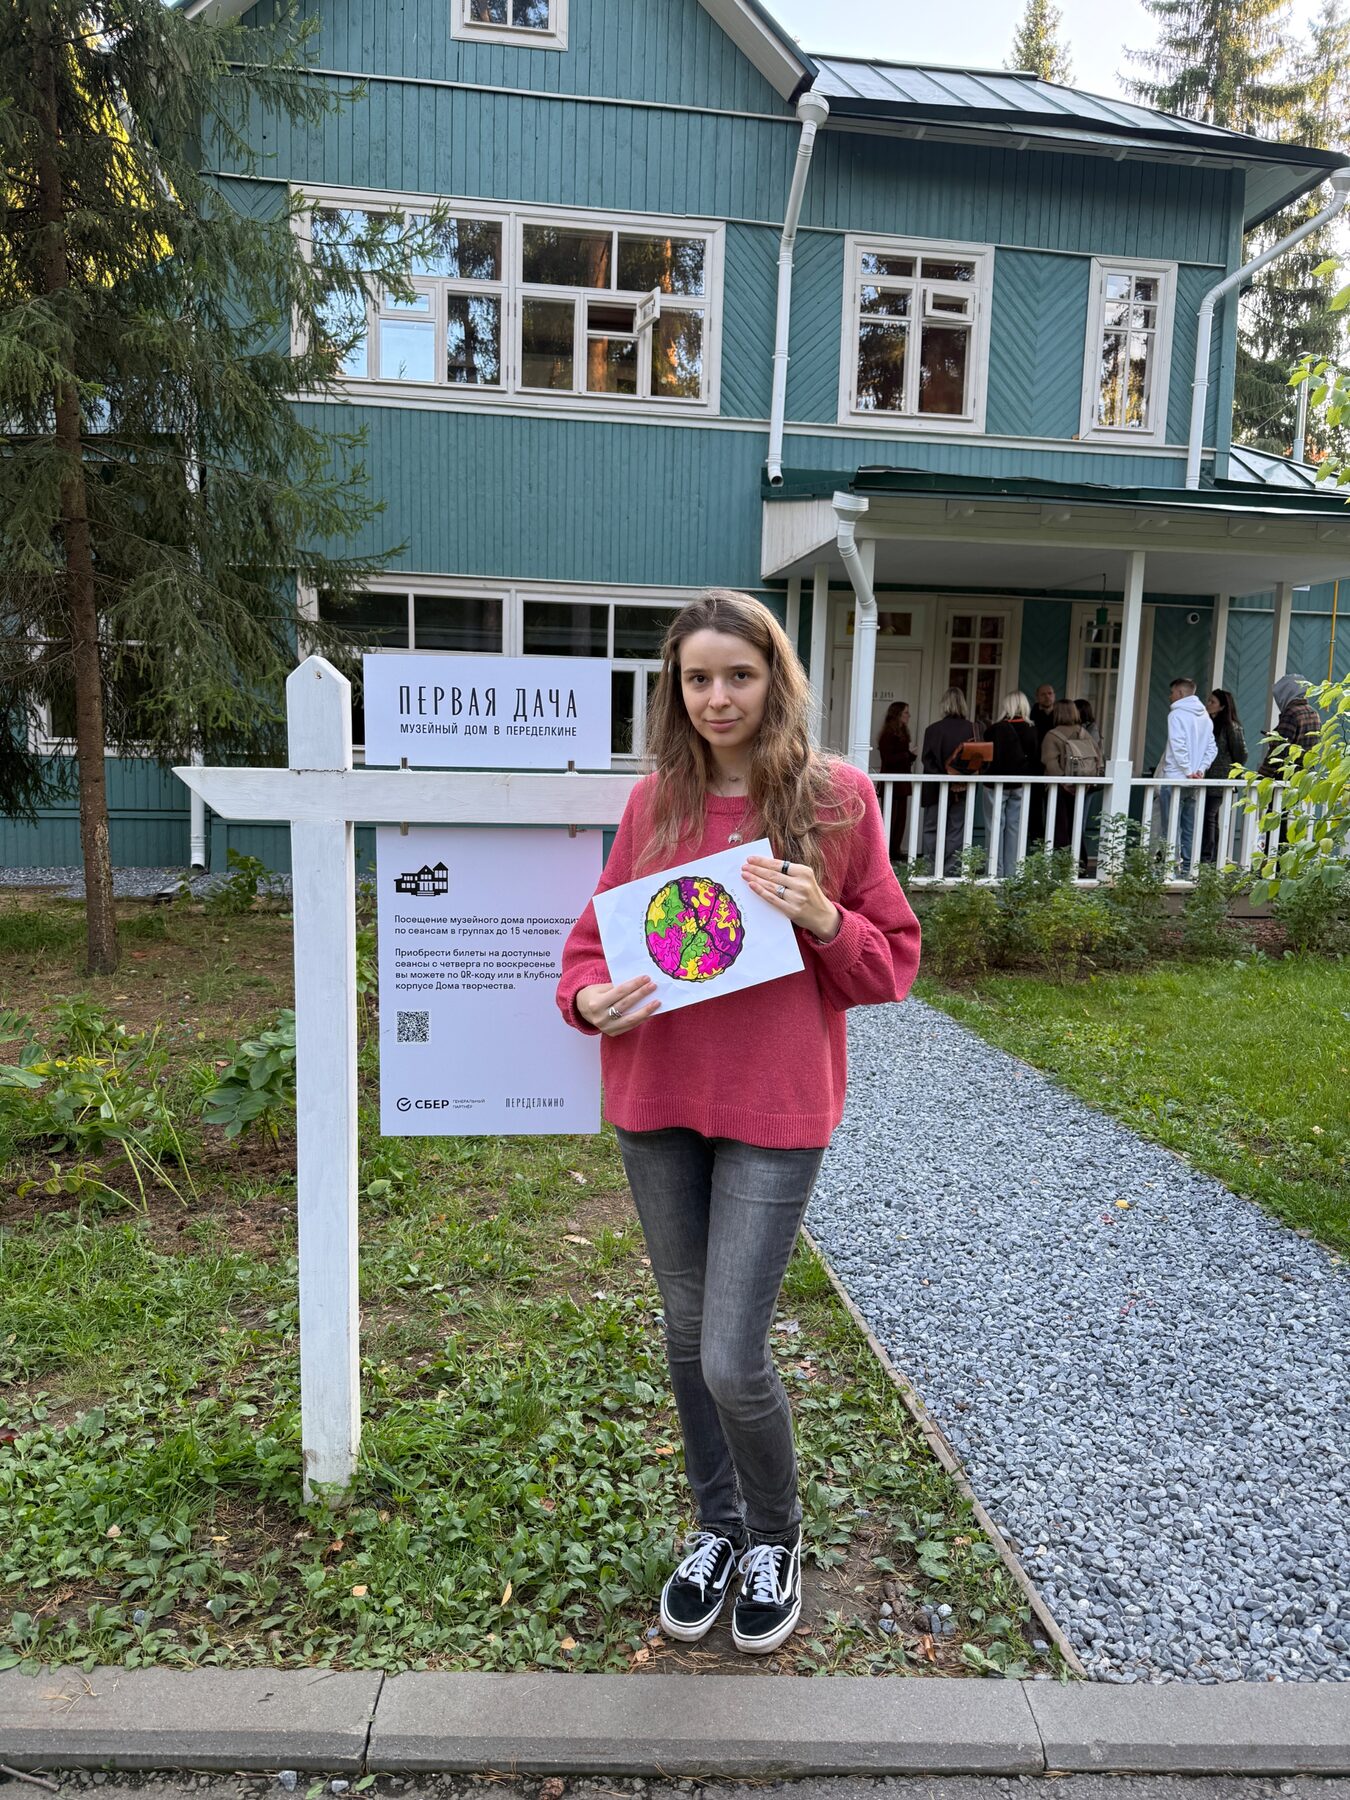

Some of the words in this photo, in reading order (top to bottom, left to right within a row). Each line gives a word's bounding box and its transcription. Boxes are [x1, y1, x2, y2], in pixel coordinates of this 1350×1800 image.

[399, 685, 496, 717] ПЕРВАЯ
[513, 688, 578, 723] ДАЧА
[400, 721, 458, 735] МУЗЕЙНЫЙ
[463, 724, 488, 736] ДОМ
[493, 725, 501, 736] В
[506, 725, 577, 737] ПЕРЕДЕЛКИНЕ
[394, 915, 448, 925] Посещение
[450, 915, 499, 926] музейного
[501, 917, 525, 925] дома
[527, 917, 579, 926] происходи
[459, 928, 495, 937] группах
[496, 928, 508, 936] до
[511, 926, 521, 935] 15
[523, 928, 562, 936] человек.
[395, 948, 451, 959] Приобрести
[453, 948, 487, 957] билеты
[502, 950, 551, 960] доступные
[440, 961, 481, 971] четверга
[497, 961, 556, 970] воскресенье
[461, 970, 496, 981] QR-коду
[524, 970, 563, 981] Клубном
[396, 983, 434, 992] корпусе
[436, 981, 460, 991] Дома
[462, 983, 516, 992] творчества.
[414, 1100, 450, 1109] СБЕР
[506, 1098, 565, 1110] ПЕРЕДЕЛКИНО
